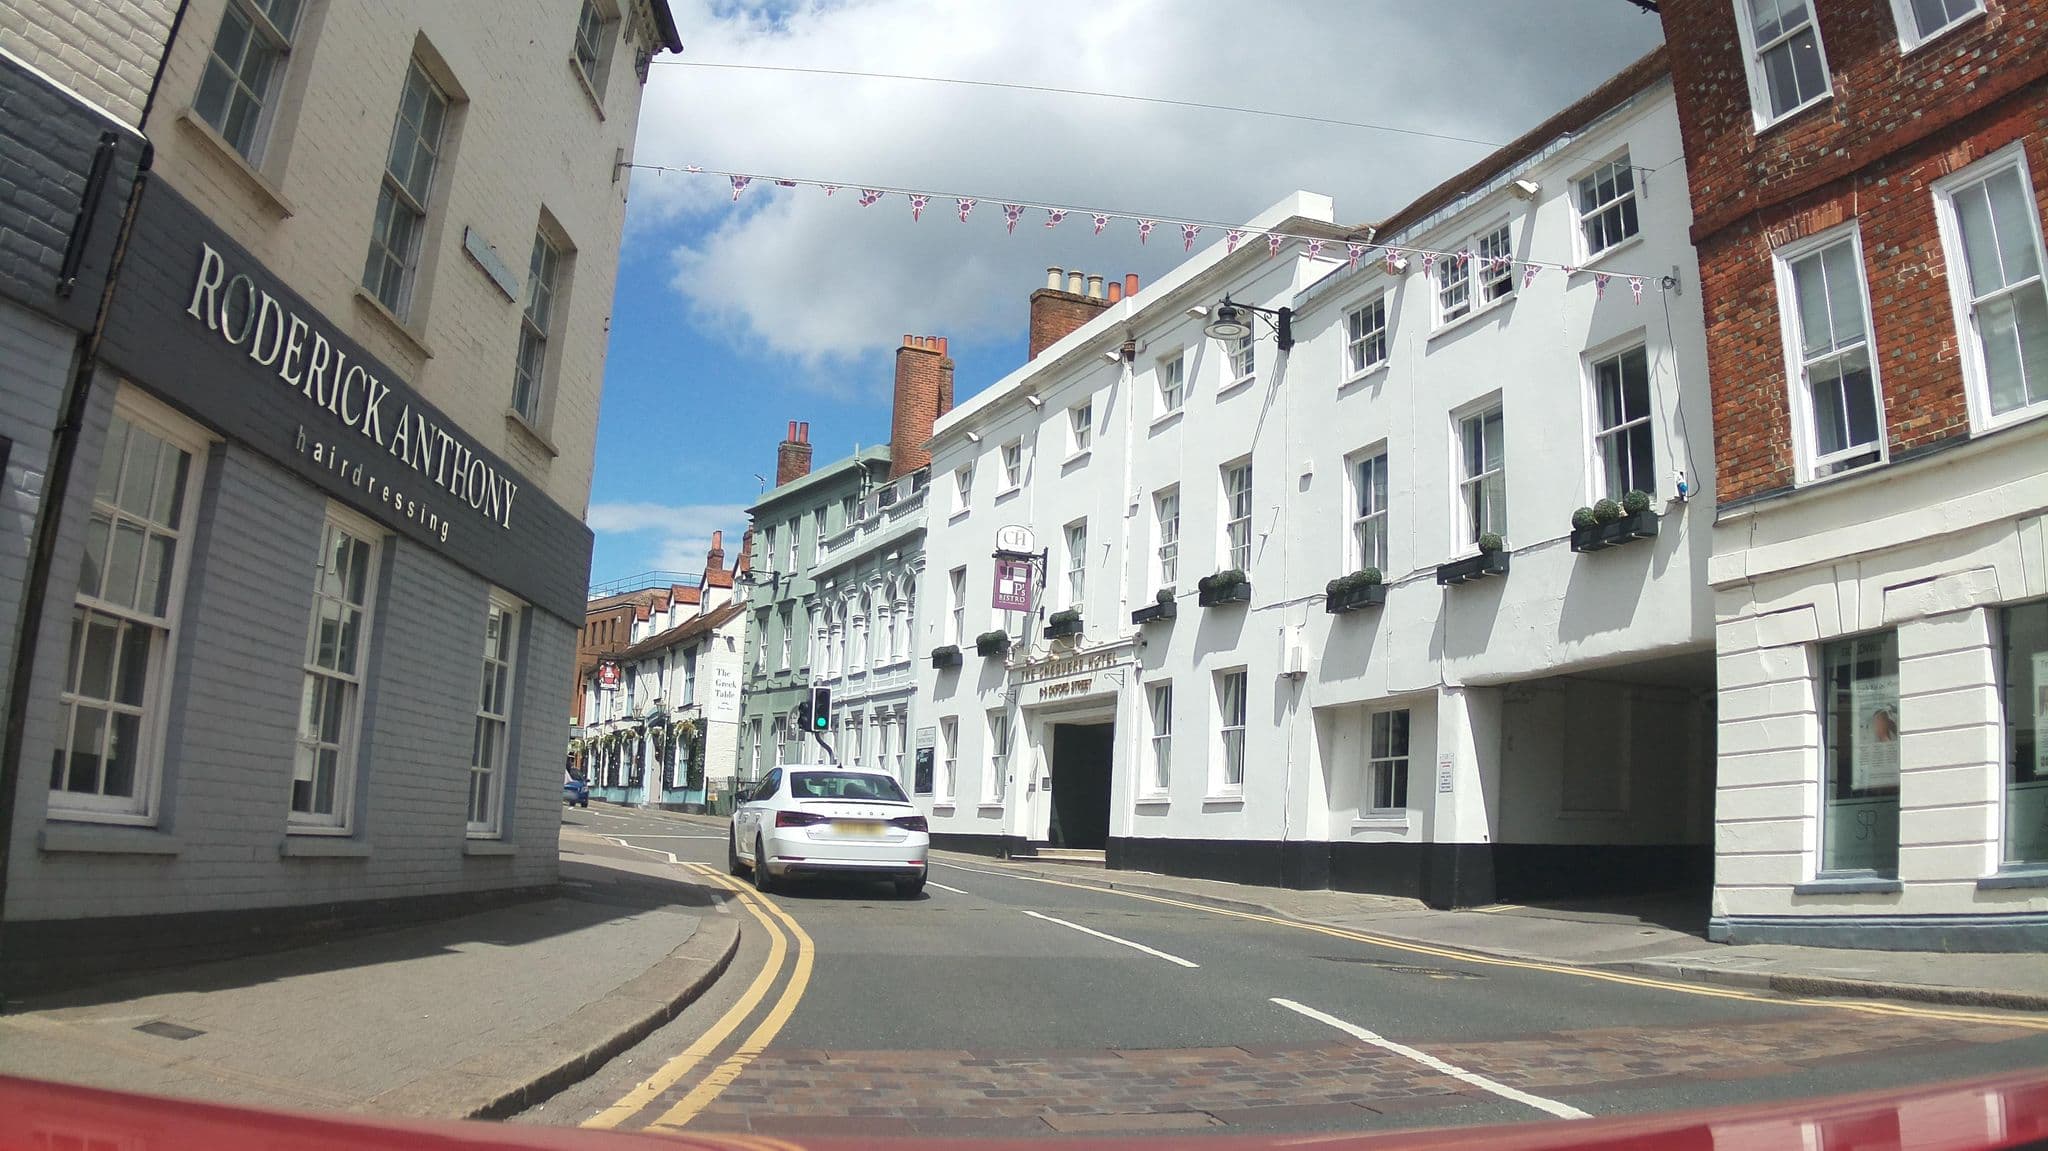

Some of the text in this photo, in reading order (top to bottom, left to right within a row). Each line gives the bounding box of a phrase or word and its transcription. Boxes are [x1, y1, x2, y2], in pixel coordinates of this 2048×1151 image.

[187, 242, 518, 530] RODERICK ANTHONY
[295, 425, 450, 543] hairdressing
[998, 594, 1026, 603] BISTRO
[1089, 652, 1118, 669] HOTEL
[715, 668, 731, 677] The
[715, 679, 736, 688] Greek
[715, 689, 736, 699] Table
